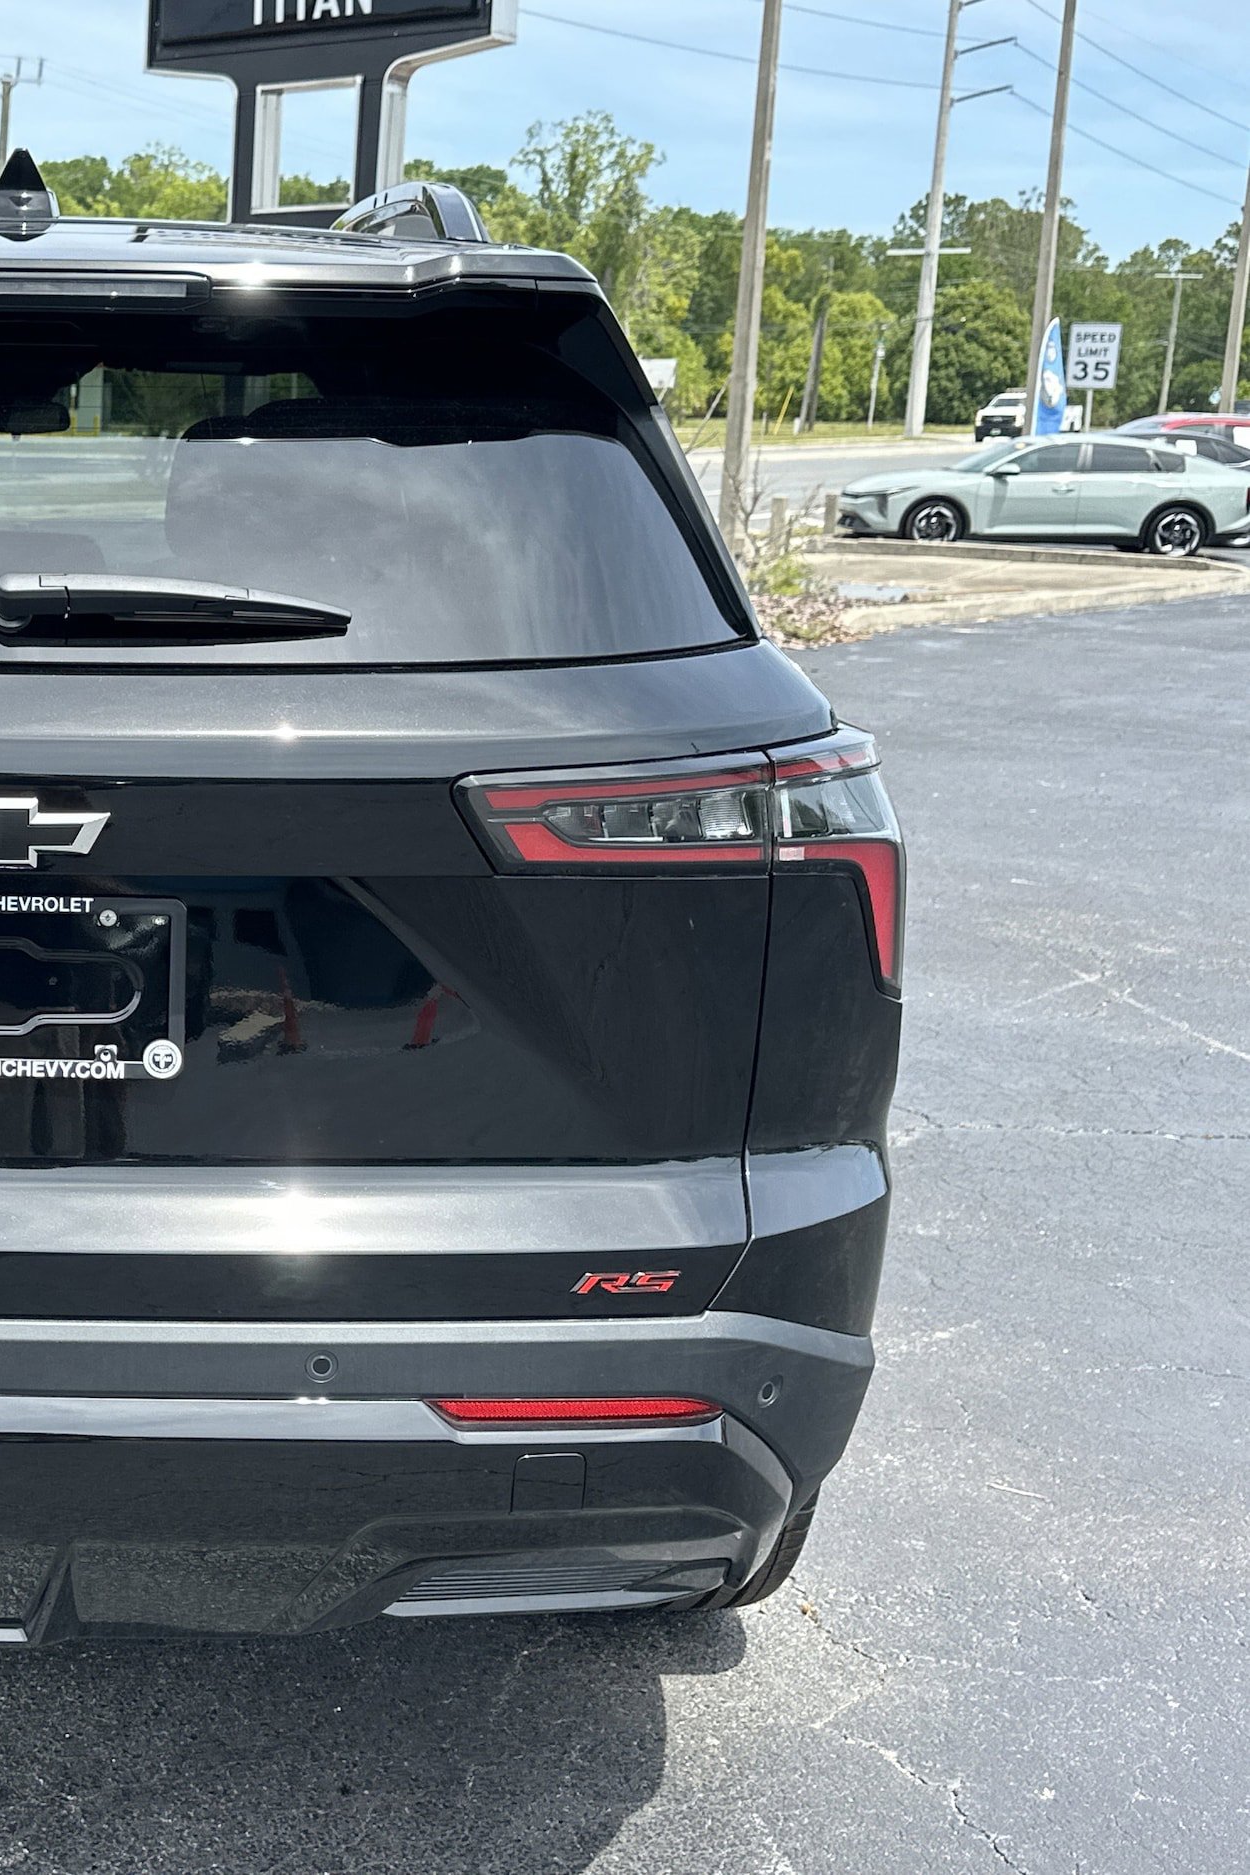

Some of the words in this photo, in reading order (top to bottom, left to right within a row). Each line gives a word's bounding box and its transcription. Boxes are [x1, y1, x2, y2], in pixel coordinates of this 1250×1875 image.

[1075, 332, 1116, 343] SPEED
[1077, 347, 1109, 358] LIMIT
[1073, 361, 1111, 381] 35
[570, 1270, 681, 1294] RS
